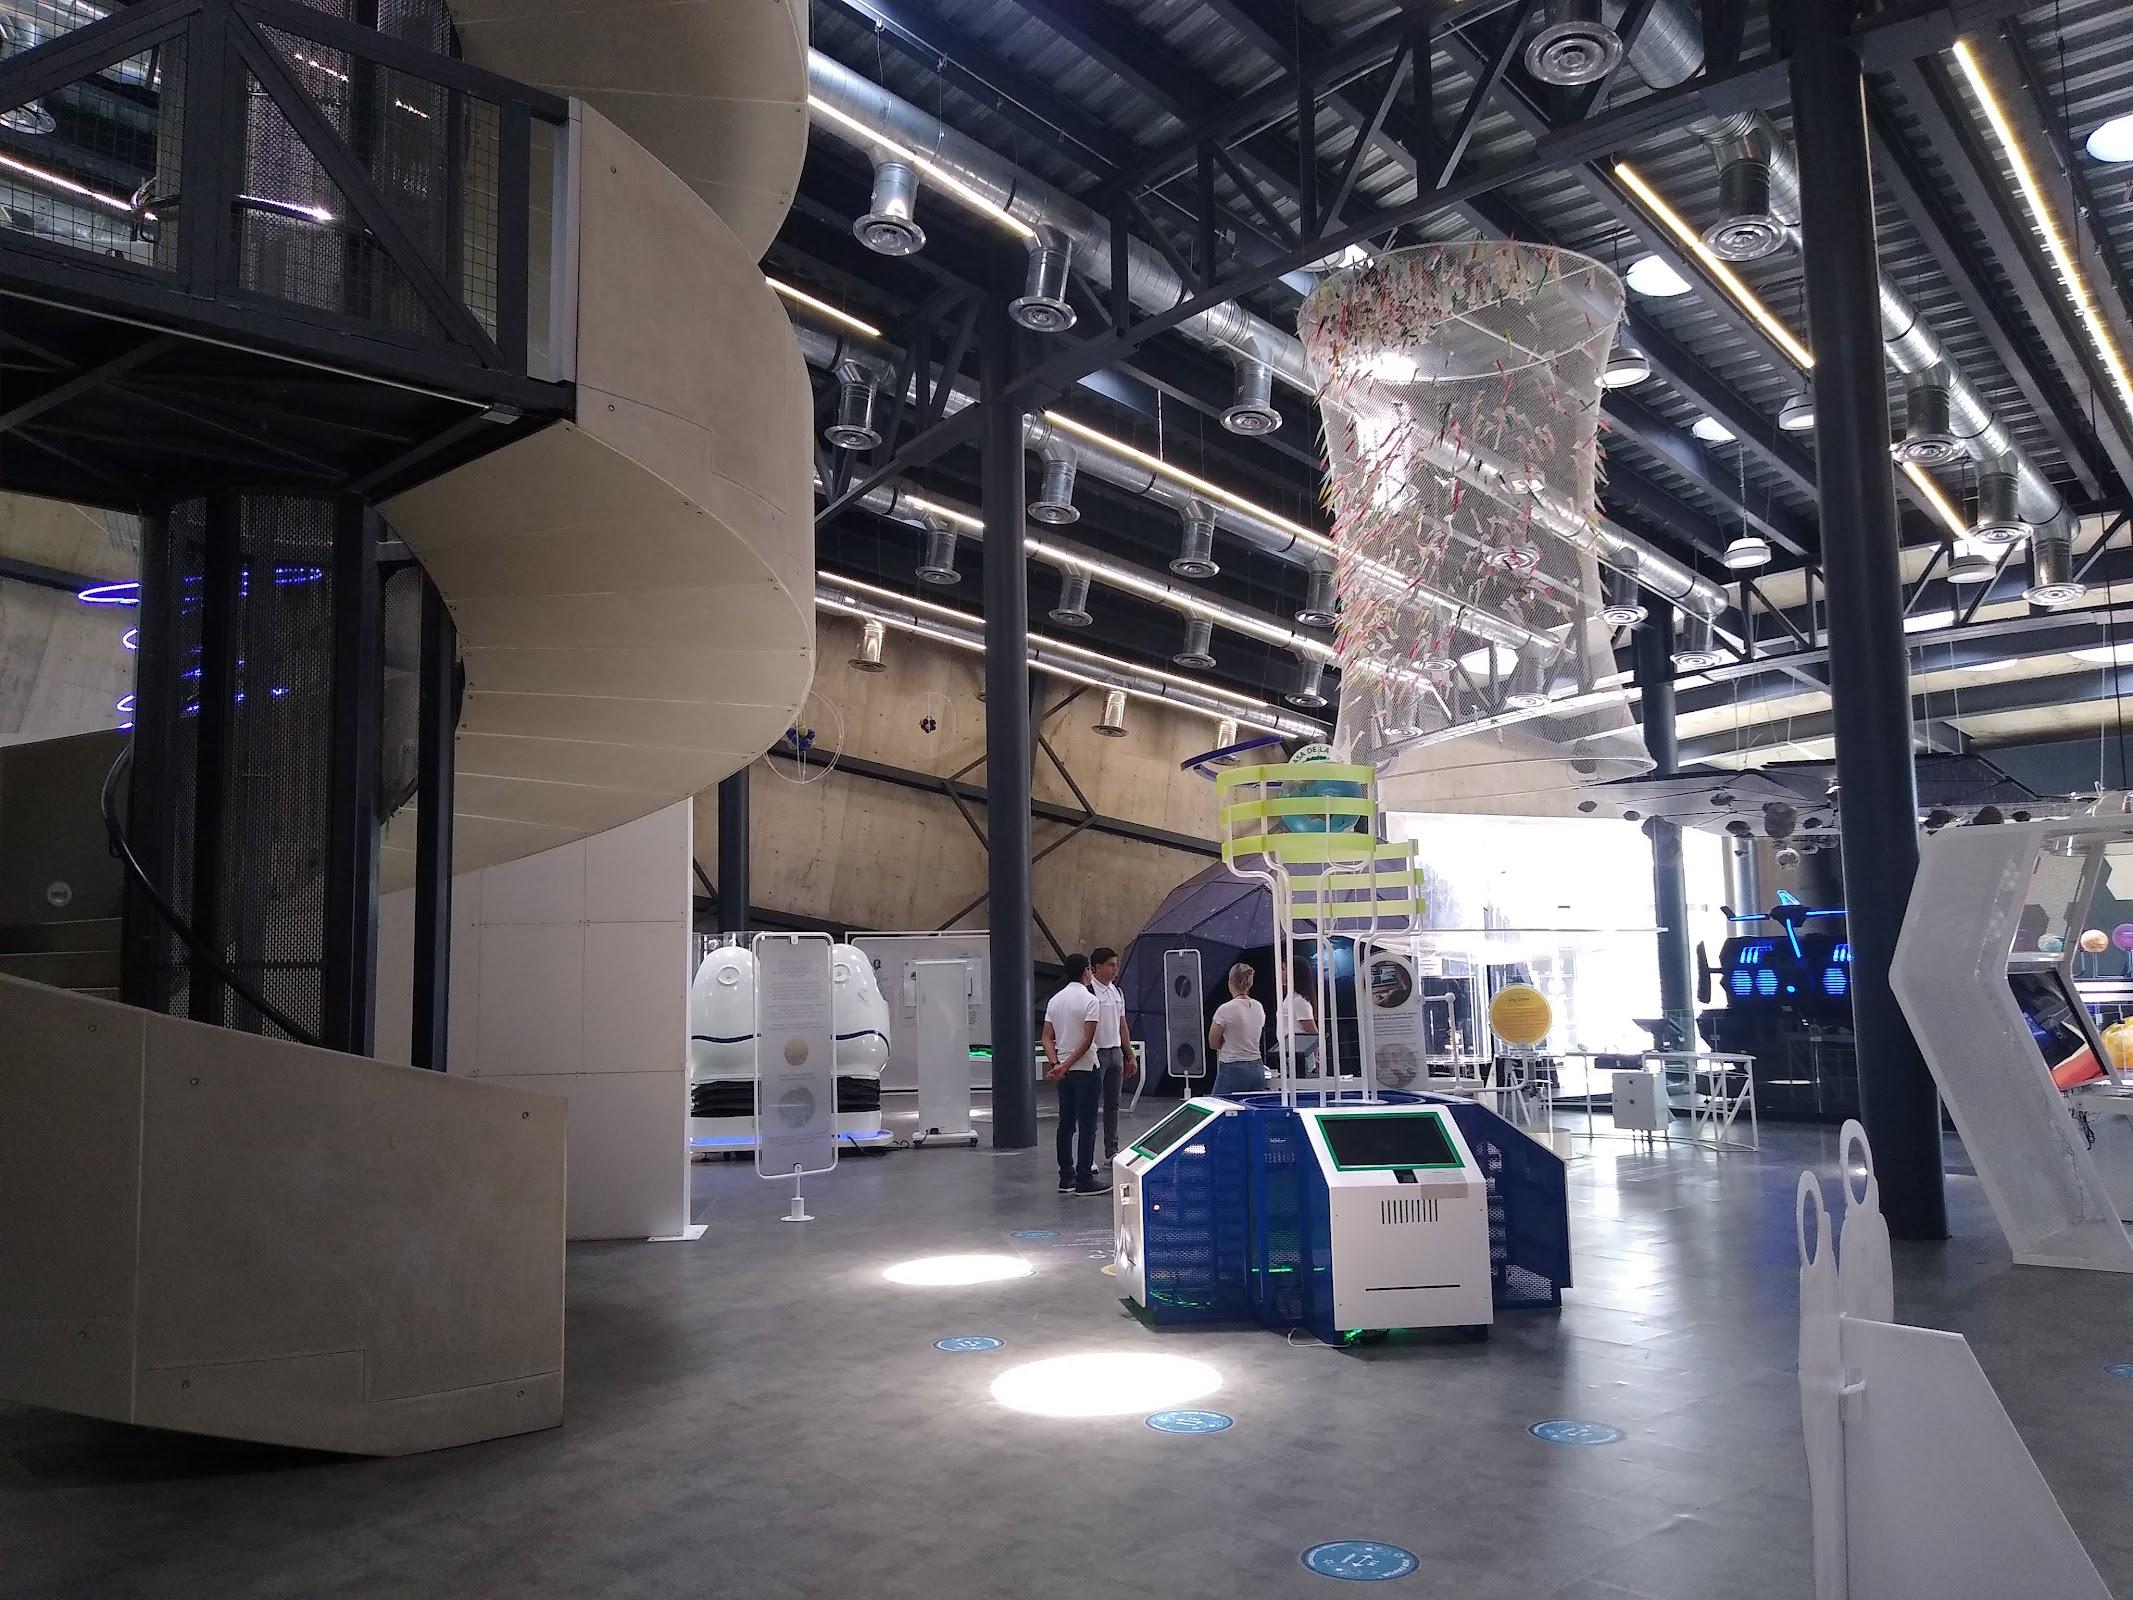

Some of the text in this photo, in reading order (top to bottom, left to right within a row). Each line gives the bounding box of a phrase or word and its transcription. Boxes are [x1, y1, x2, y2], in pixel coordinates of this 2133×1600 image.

[1292, 746, 1330, 764] ASA DE LA
